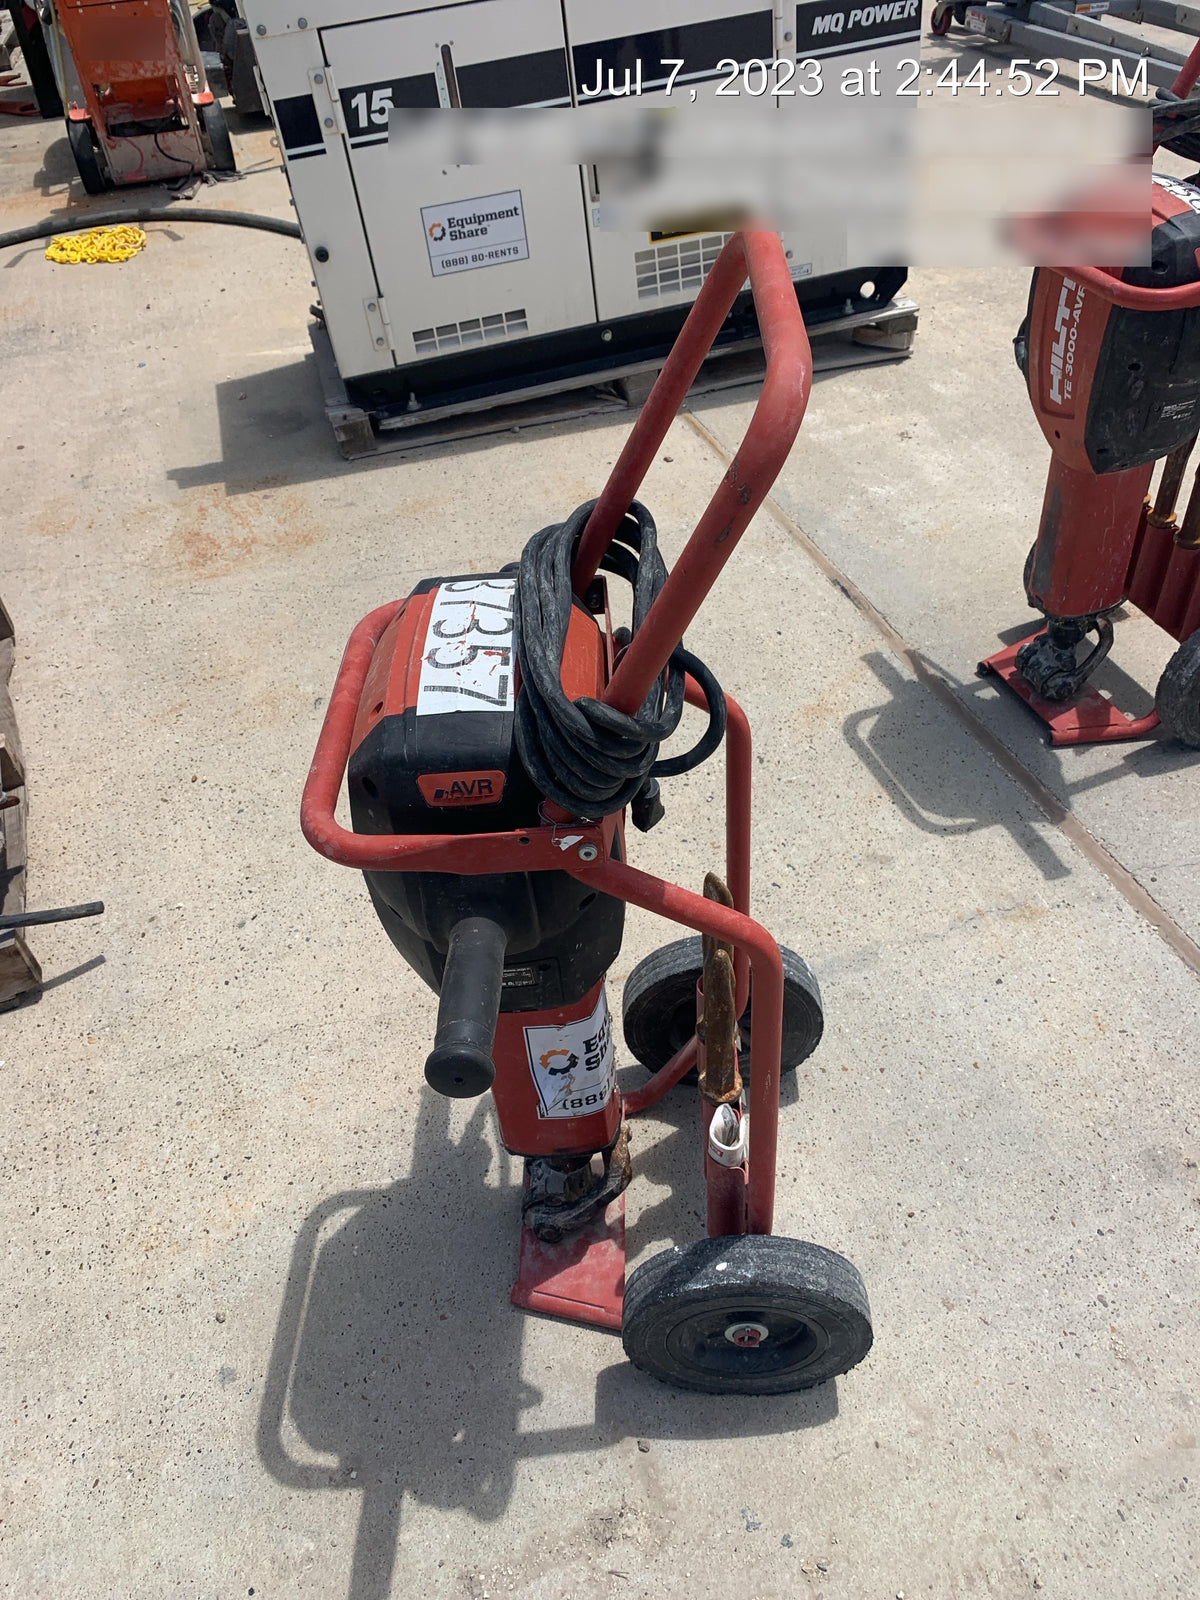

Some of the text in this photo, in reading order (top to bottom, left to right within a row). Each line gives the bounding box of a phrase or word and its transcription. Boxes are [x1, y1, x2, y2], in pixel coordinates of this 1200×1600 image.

[812, 0, 918, 36] MQ POWER
[351, 87, 395, 128] 15
[447, 206, 520, 229] Equipment
[449, 226, 489, 242] Share
[441, 246, 519, 269] (888) 80-RENTS
[1050, 277, 1077, 405] HILTI
[1064, 379, 1072, 400] TE
[450, 778, 494, 796] AVR
